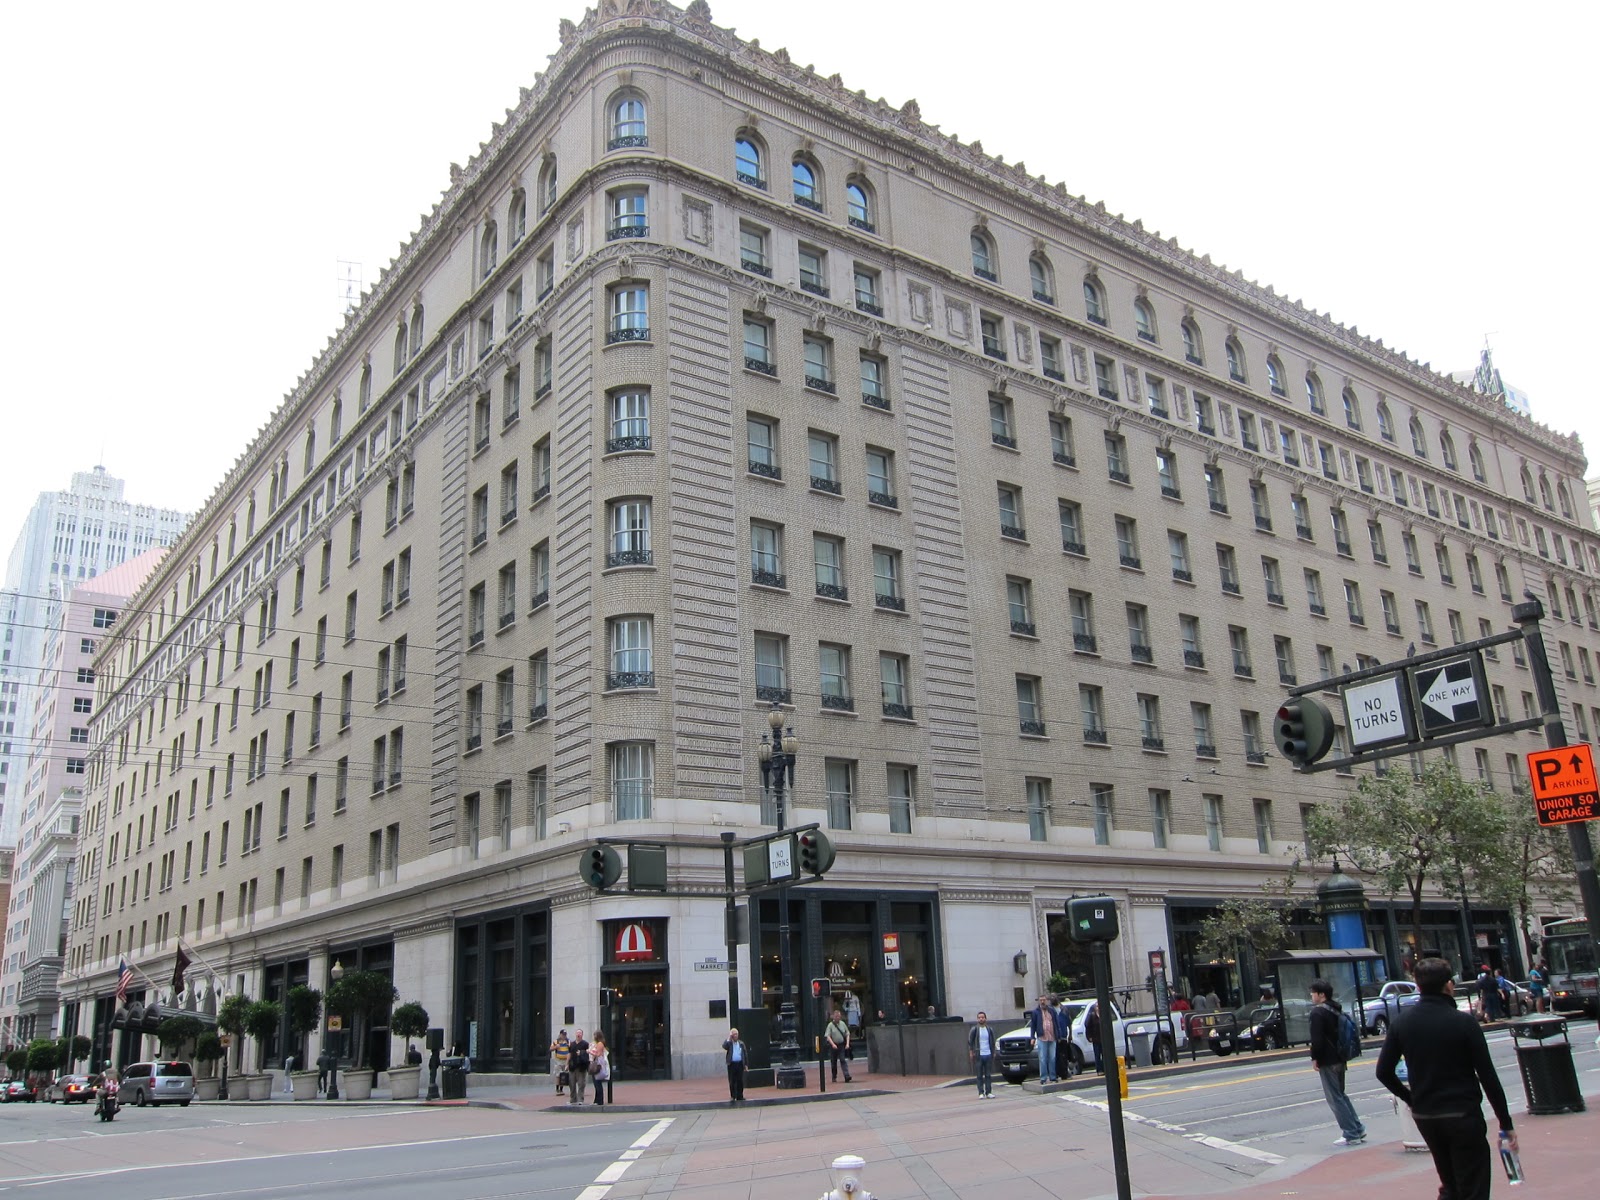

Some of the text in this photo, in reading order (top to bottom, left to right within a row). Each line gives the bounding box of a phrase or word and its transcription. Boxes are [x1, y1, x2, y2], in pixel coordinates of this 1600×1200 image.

[1428, 686, 1471, 703] ONE WAY
[1364, 698, 1382, 712] NO
[1355, 710, 1398, 730] TURNS
[1539, 797, 1573, 811] UNION
[1548, 806, 1593, 820] GARAGE
[776, 850, 784, 858] NO
[772, 859, 790, 869] TURNS
